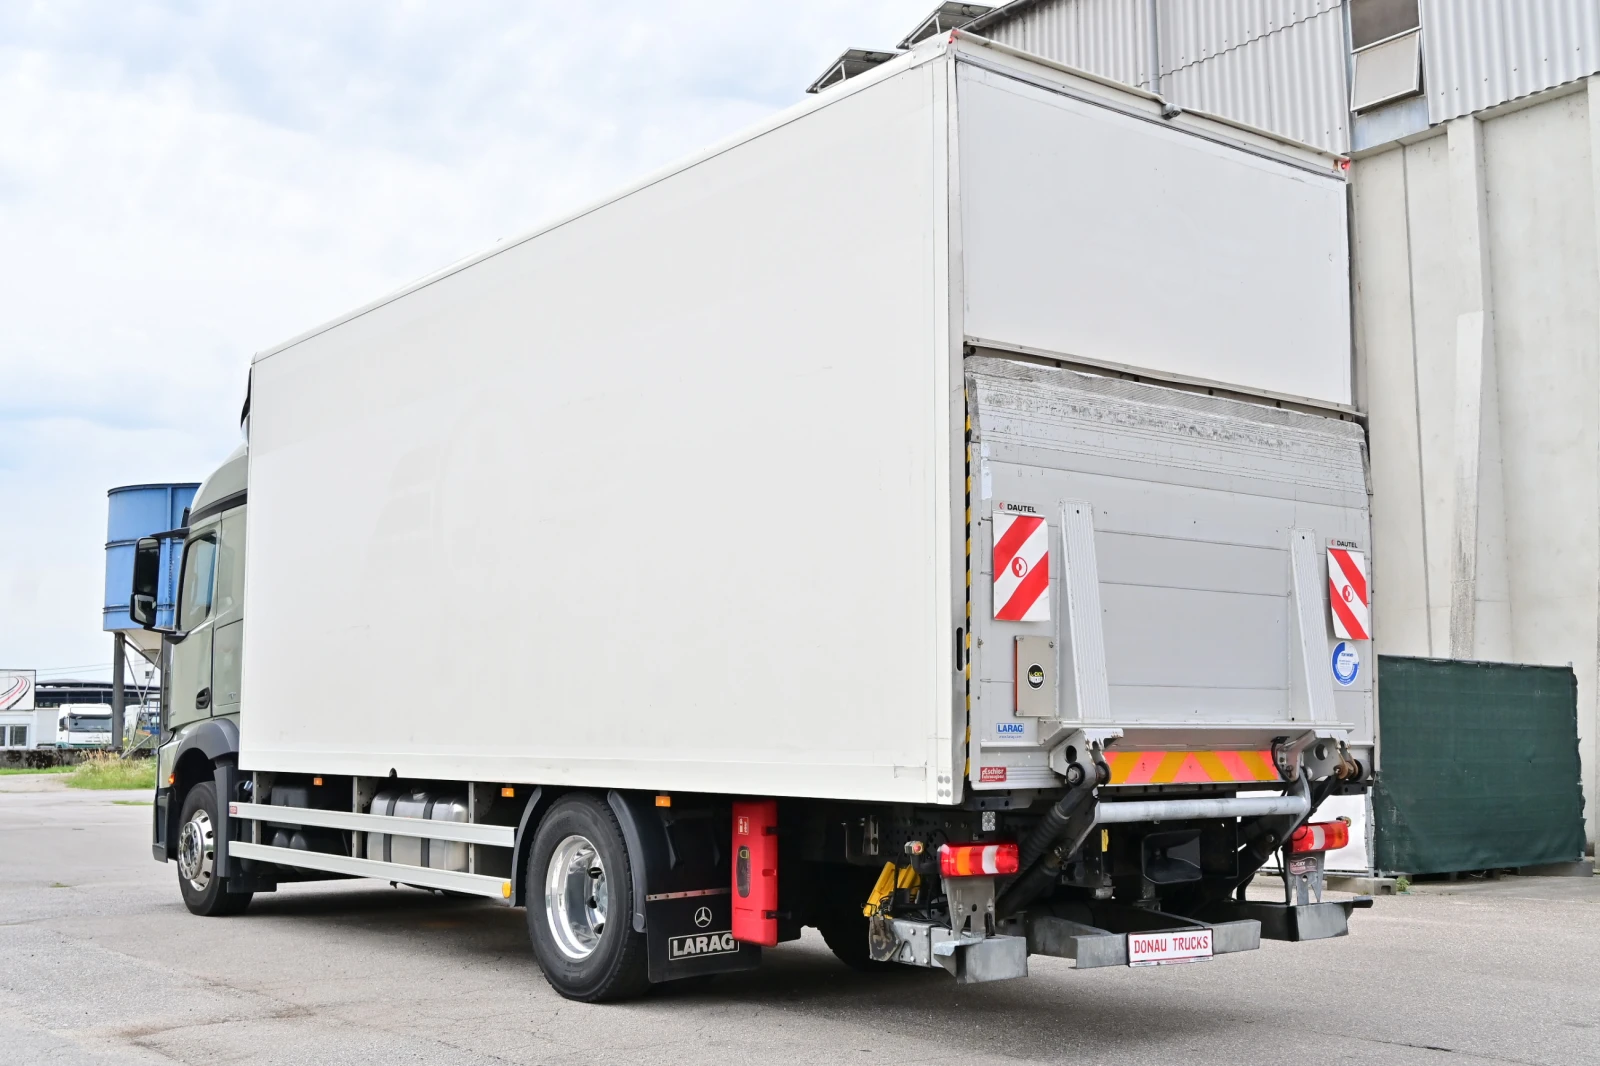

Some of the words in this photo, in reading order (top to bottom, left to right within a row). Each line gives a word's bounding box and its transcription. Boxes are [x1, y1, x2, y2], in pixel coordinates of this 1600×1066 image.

[1007, 503, 1036, 513] DAUTEL
[1337, 540, 1358, 548] DAUTEL
[997, 724, 1023, 733] LARAG
[673, 933, 735, 957] LARAG
[1133, 938, 1167, 954] DONAU
[1172, 936, 1209, 951] TRUCKS
